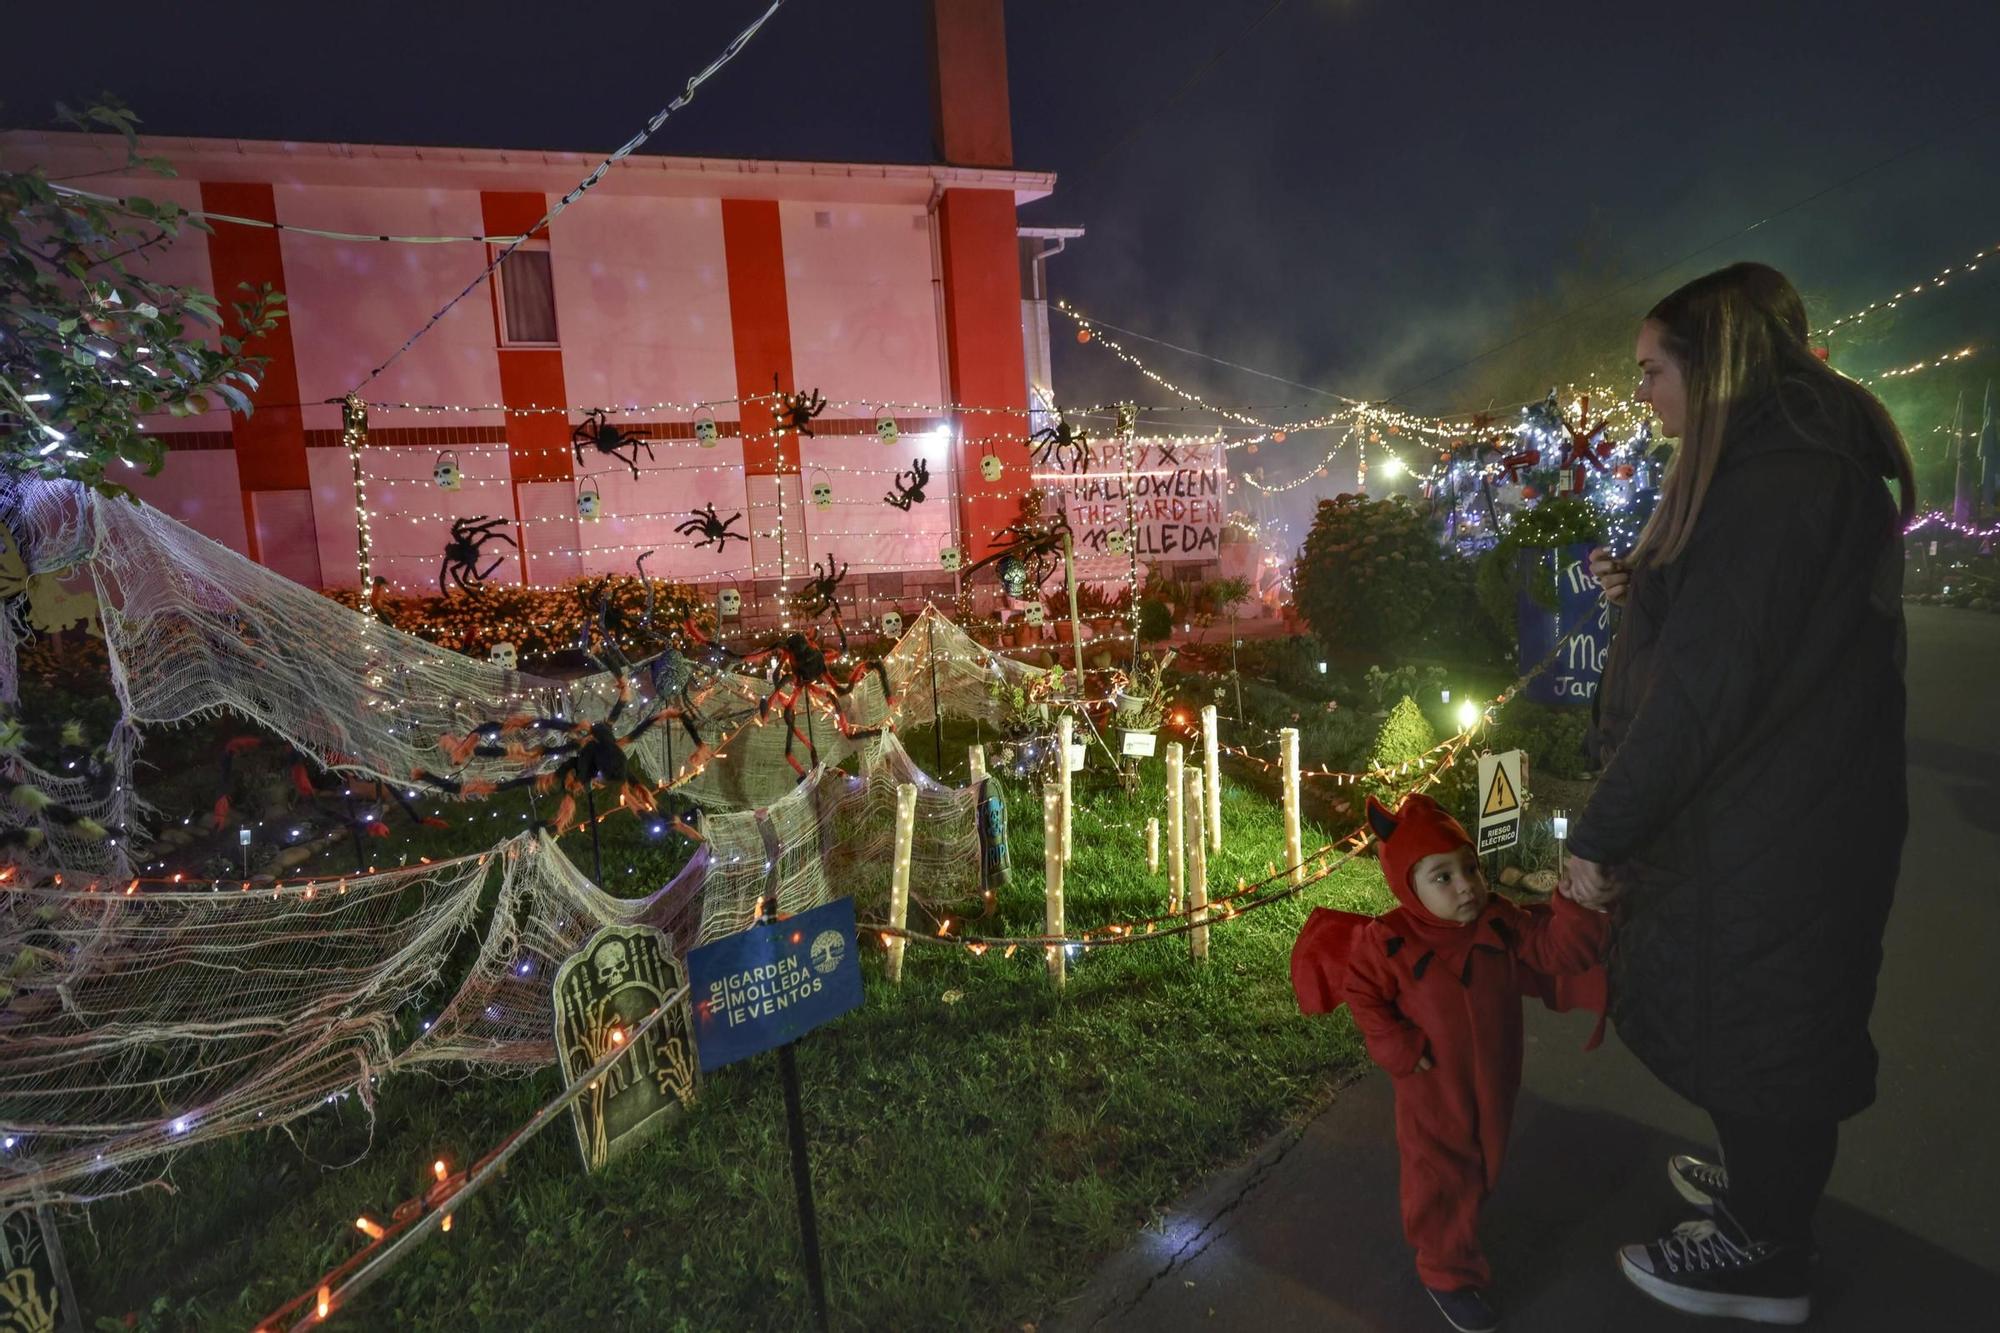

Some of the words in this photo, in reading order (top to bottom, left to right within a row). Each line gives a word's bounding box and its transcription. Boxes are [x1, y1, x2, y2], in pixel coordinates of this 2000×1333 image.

[1075, 467, 1217, 501] HALLOWEEN
[1073, 505, 1116, 526] THE
[1083, 525, 1217, 555] MLLEDA
[1554, 676, 1599, 699] Jar
[1487, 824, 1511, 838] RIESGO
[729, 955, 798, 989] GARDEN
[731, 967, 811, 1007] MOLLEDA
[708, 980, 726, 1014] the
[735, 978, 823, 1024] EVENTOS
